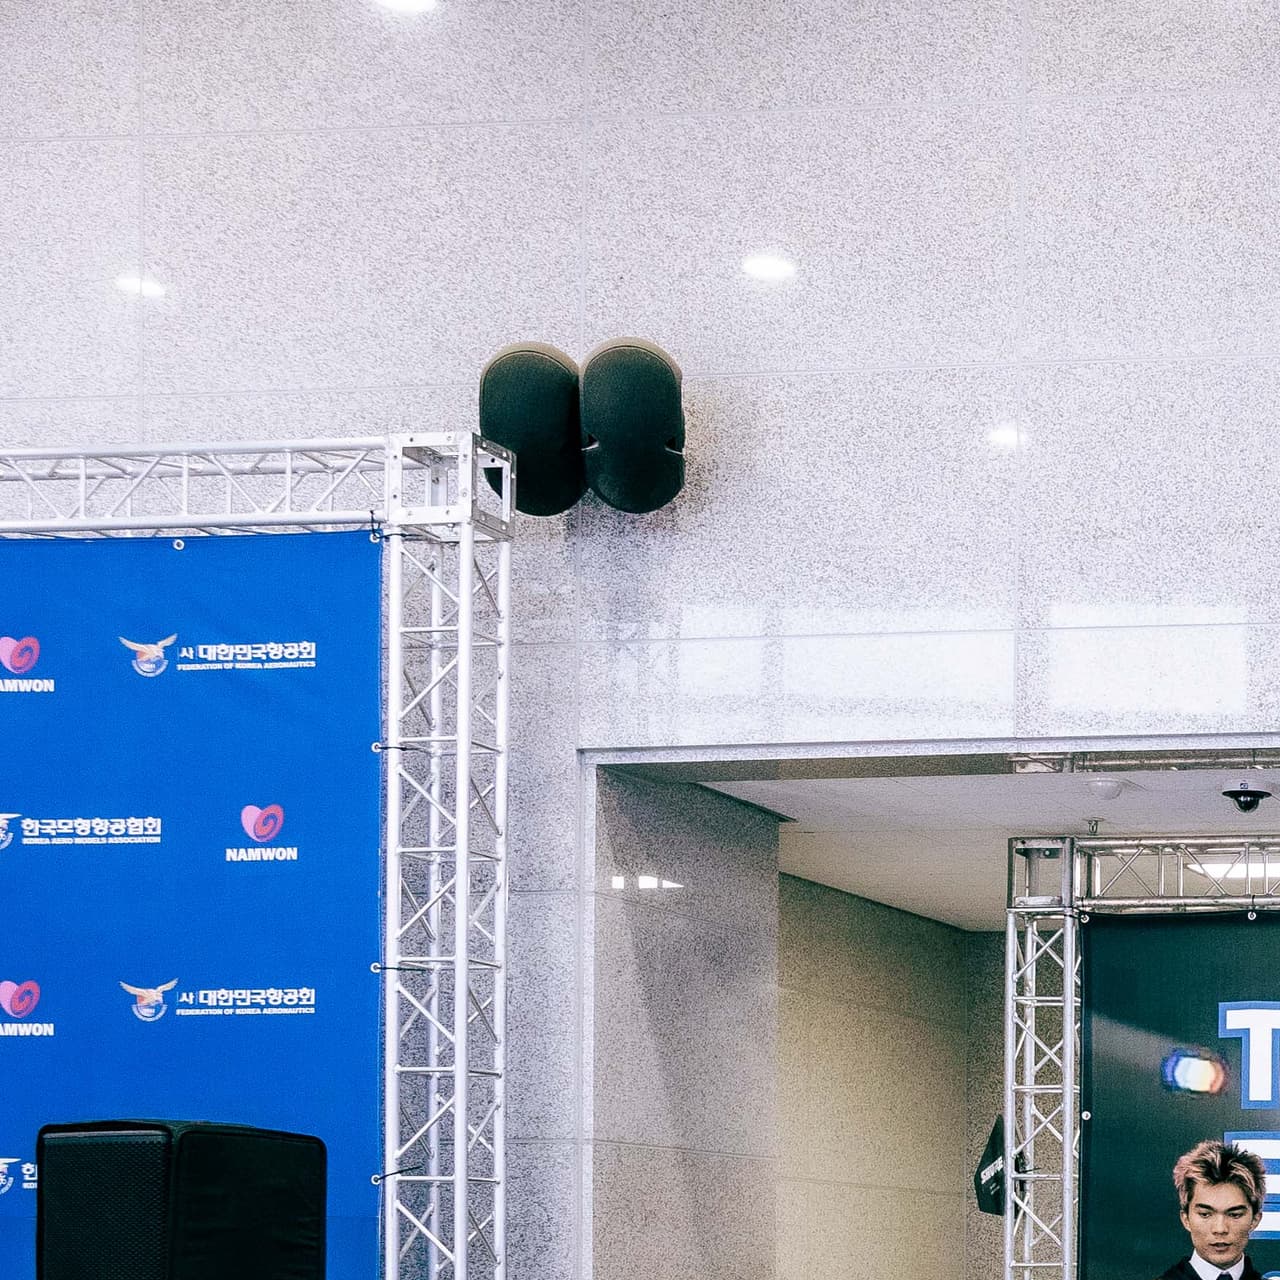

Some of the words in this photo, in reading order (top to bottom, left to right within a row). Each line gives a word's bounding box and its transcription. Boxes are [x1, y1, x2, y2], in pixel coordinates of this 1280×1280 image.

[198, 641, 315, 661] 대한민국항공회
[21, 817, 161, 837] 한국모형항공협회
[225, 847, 298, 862] NAMWON
[198, 987, 315, 1006] 대한민국항공회
